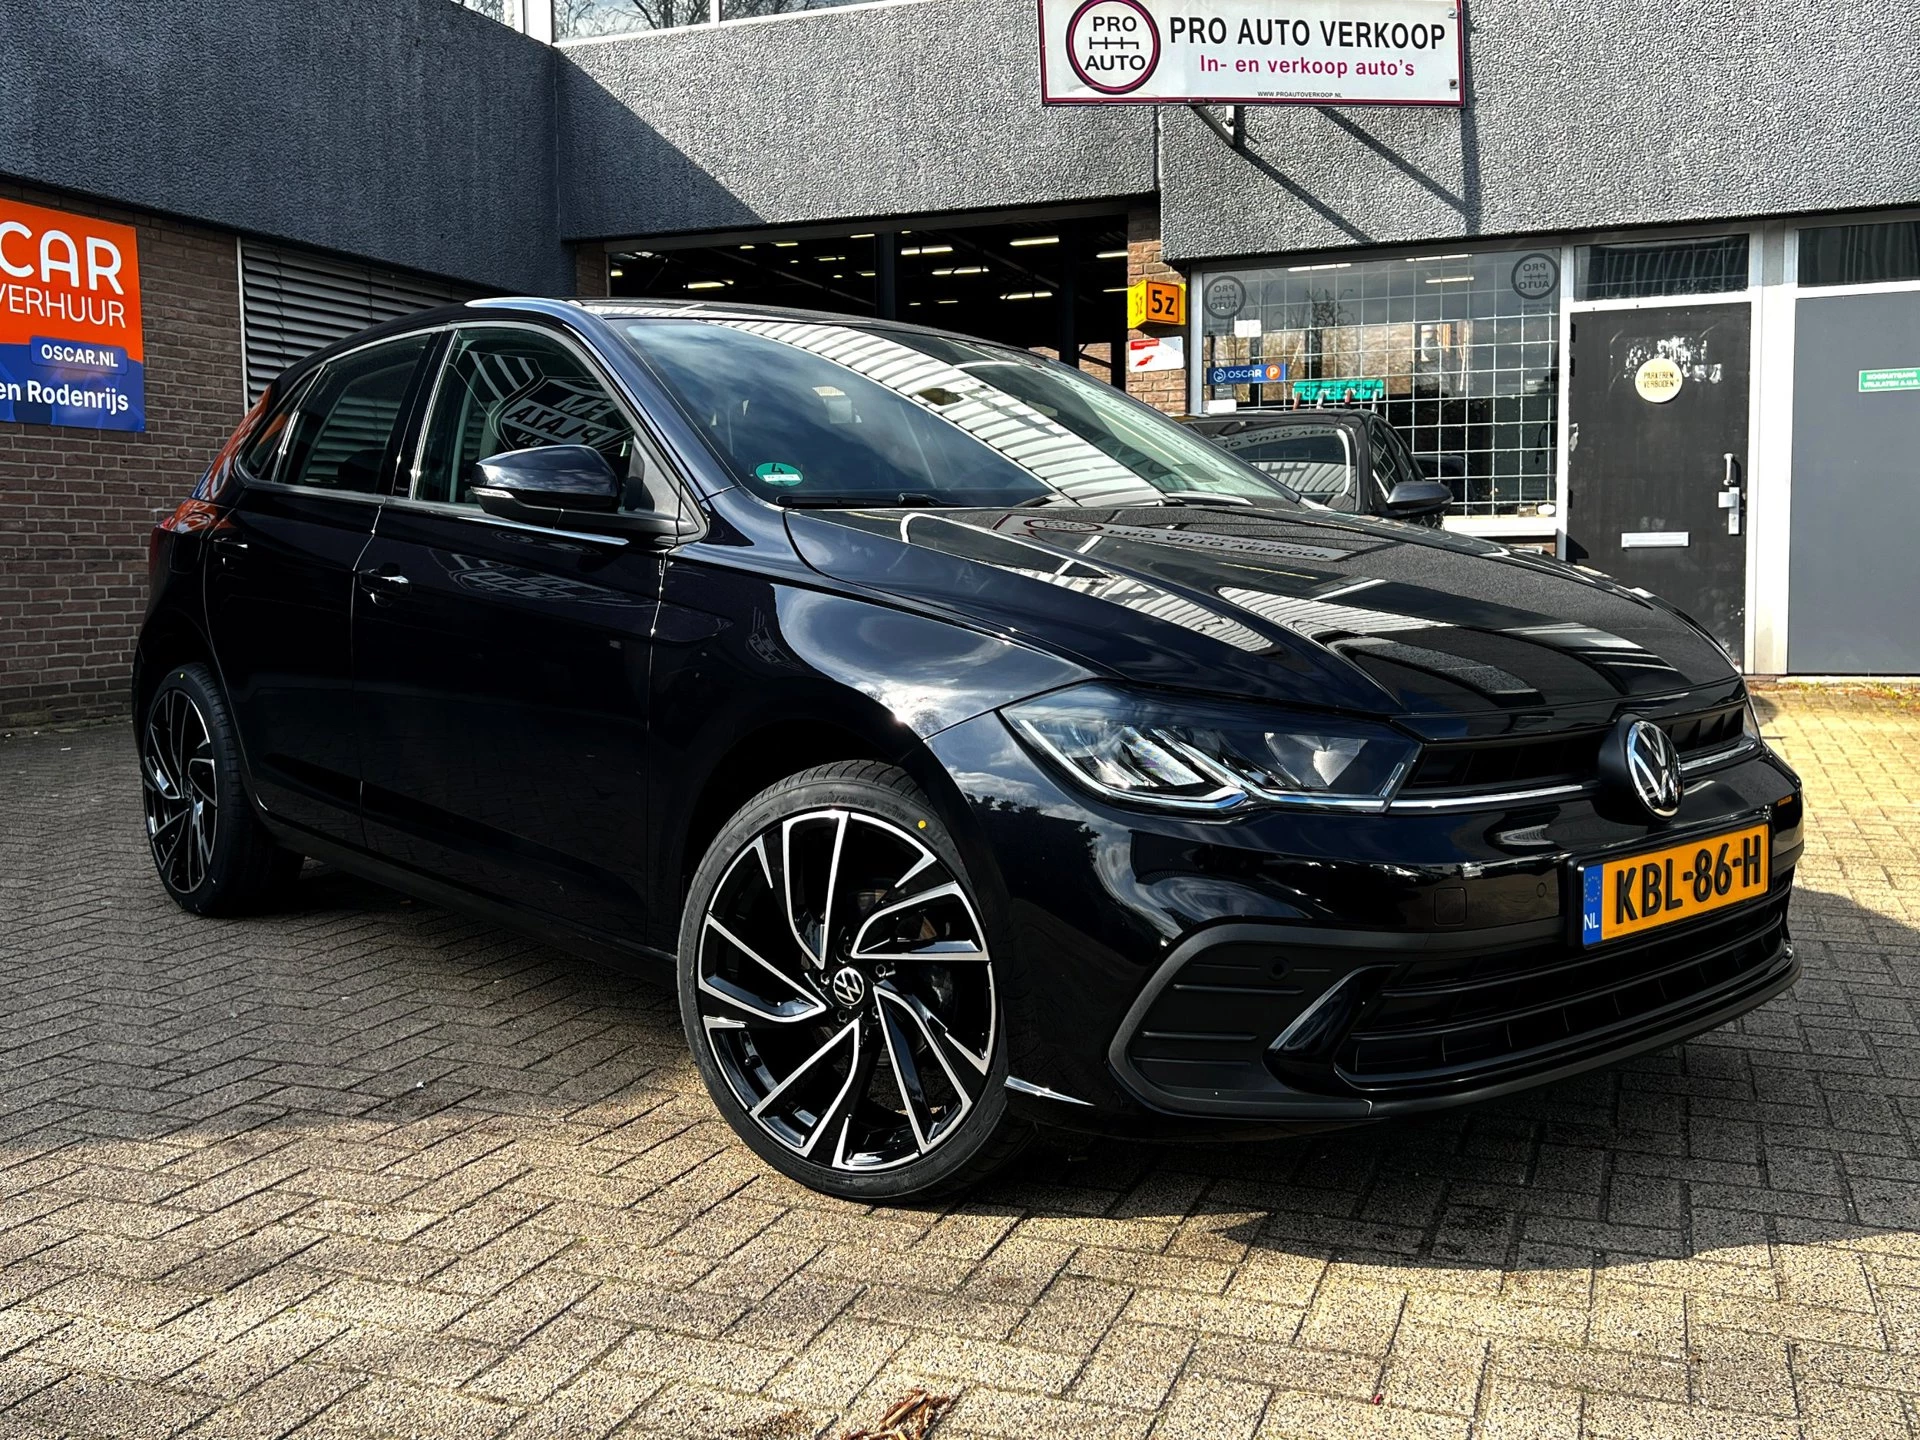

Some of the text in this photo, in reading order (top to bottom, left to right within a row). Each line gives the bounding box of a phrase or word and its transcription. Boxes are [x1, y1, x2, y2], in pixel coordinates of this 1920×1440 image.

[1093, 16, 1137, 32] PRO
[1170, 17, 1445, 49] PRO AUTO VERKOOP
[1084, 55, 1146, 70] AUTO
[1200, 55, 1415, 78] In- en verkoop auto's
[41, 344, 118, 368] OSCAR.NL
[1228, 367, 1278, 378] OSCAR P
[27, 380, 129, 415] Rodenrijs
[1615, 834, 1761, 925] KBL-86-H
[1584, 912, 1599, 930] NL
